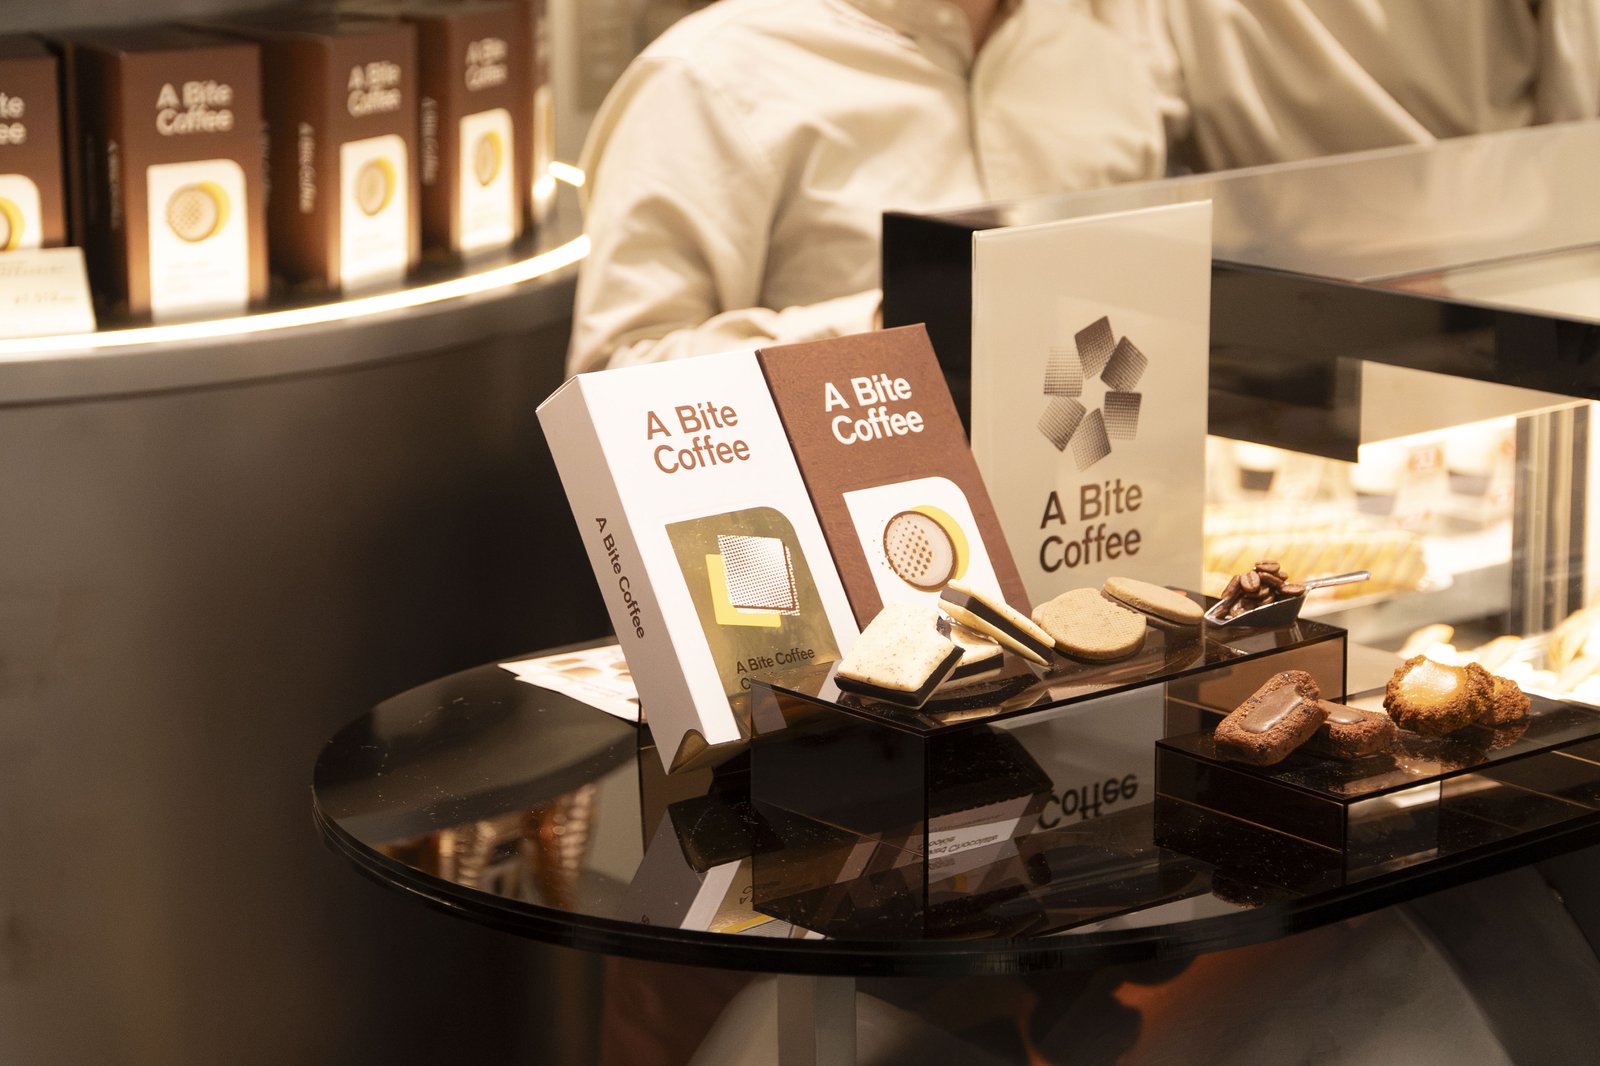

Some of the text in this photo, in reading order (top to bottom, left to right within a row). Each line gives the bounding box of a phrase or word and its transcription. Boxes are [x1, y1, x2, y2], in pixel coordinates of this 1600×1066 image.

[348, 60, 402, 91] A Bite
[0, 92, 25, 118] te
[156, 80, 233, 109] A Bite
[347, 85, 402, 118] Coffee
[0, 122, 27, 145] ee
[156, 103, 234, 136] Coffee
[825, 373, 912, 412] A Bite
[647, 401, 738, 440] A Bite
[831, 406, 925, 445] Coffee
[654, 435, 750, 474] Coffee
[1040, 478, 1142, 529] A Bite
[1040, 523, 1141, 573] Coffee
[595, 517, 645, 639] A Bite Coffee
[736, 647, 816, 674] A Bite Coffee
